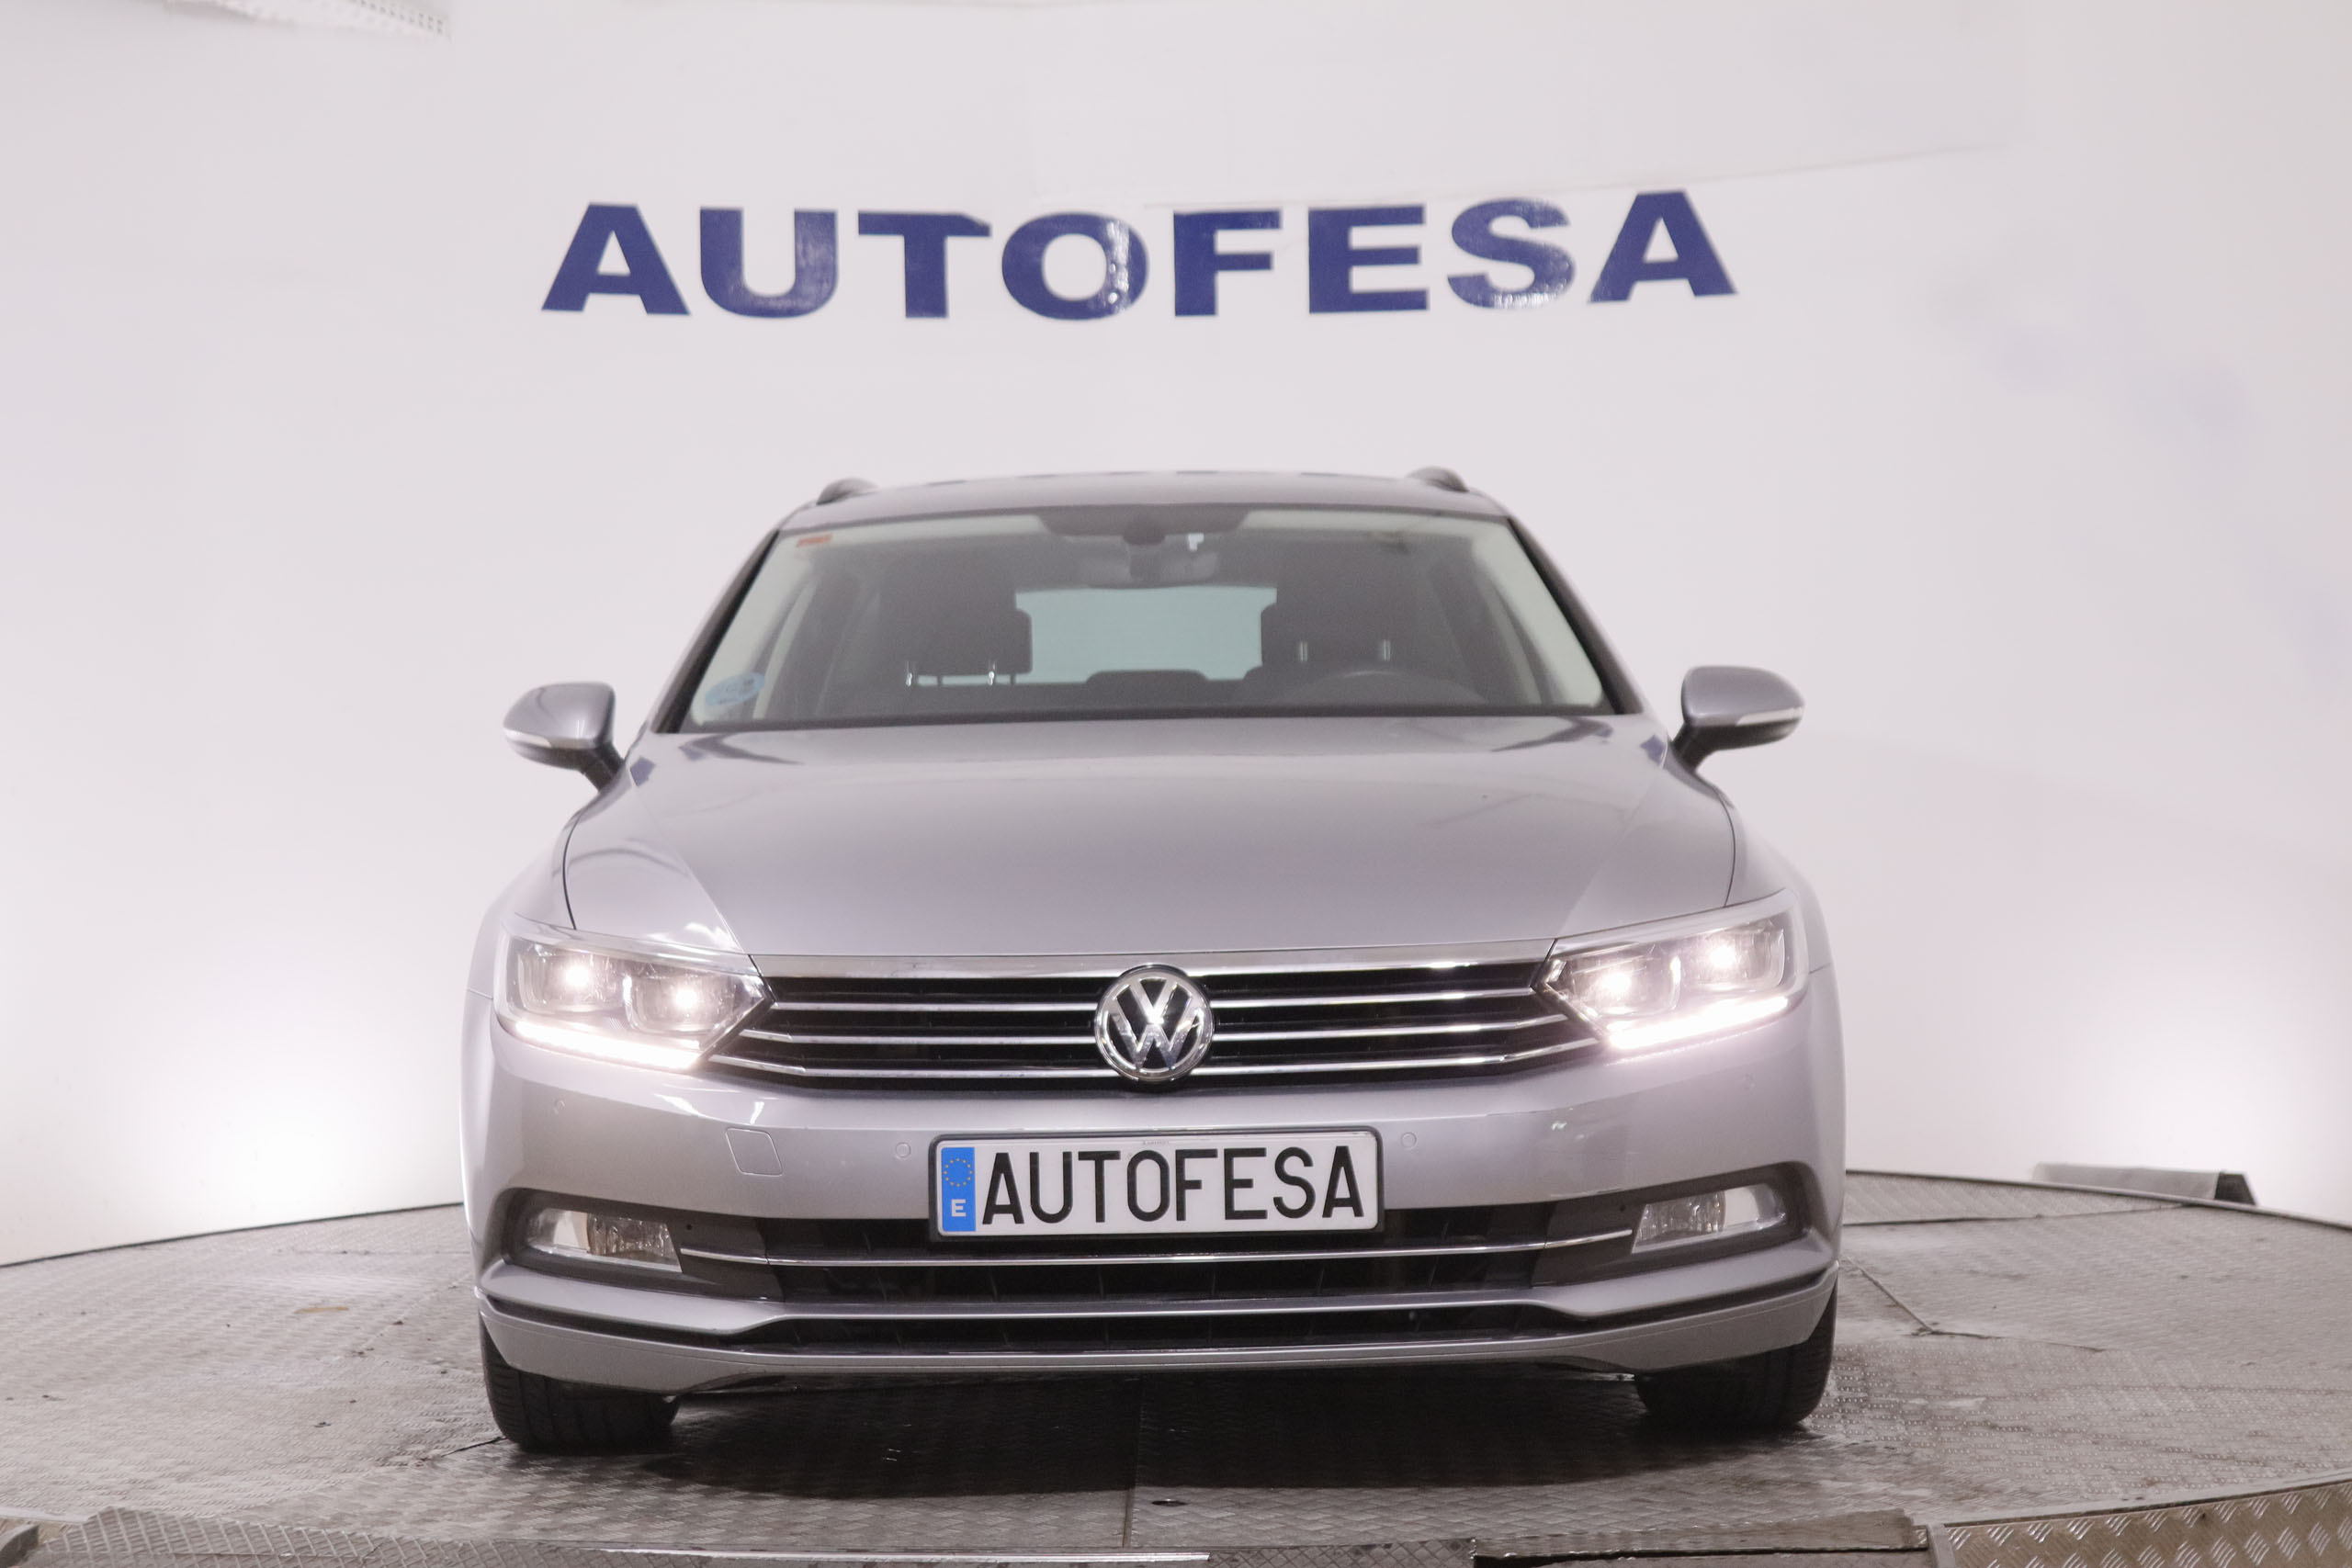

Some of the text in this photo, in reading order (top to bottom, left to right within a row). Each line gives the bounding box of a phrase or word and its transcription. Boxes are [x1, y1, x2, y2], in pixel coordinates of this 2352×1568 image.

[542, 189, 1736, 321] AUTOFESA
[1102, 972, 1206, 1075] VW
[950, 1199, 967, 1218] E
[981, 1145, 1364, 1225] AUTOFESA
